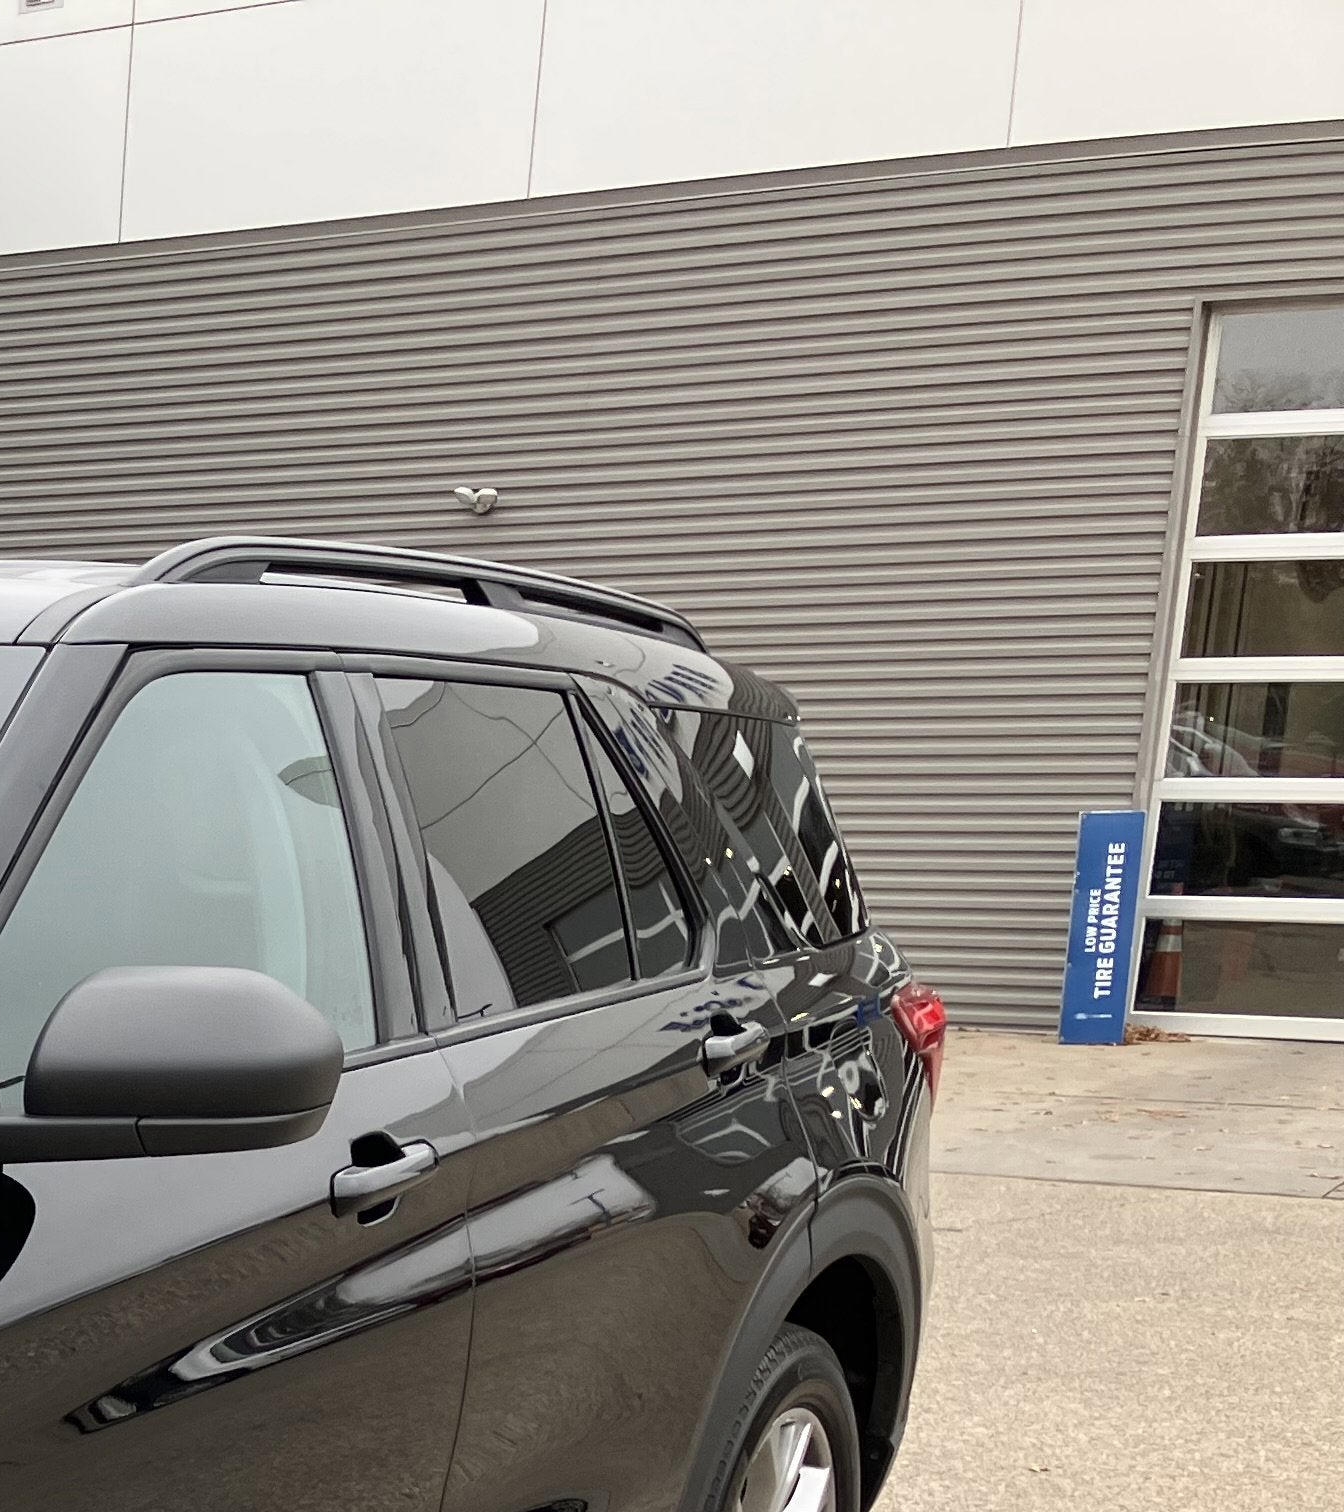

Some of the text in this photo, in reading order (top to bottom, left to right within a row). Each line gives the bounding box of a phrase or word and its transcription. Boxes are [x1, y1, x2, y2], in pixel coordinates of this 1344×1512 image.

[1085, 888, 1102, 953] LOW PRICE
[1094, 842, 1126, 1000] TIRE GUARANTEE
